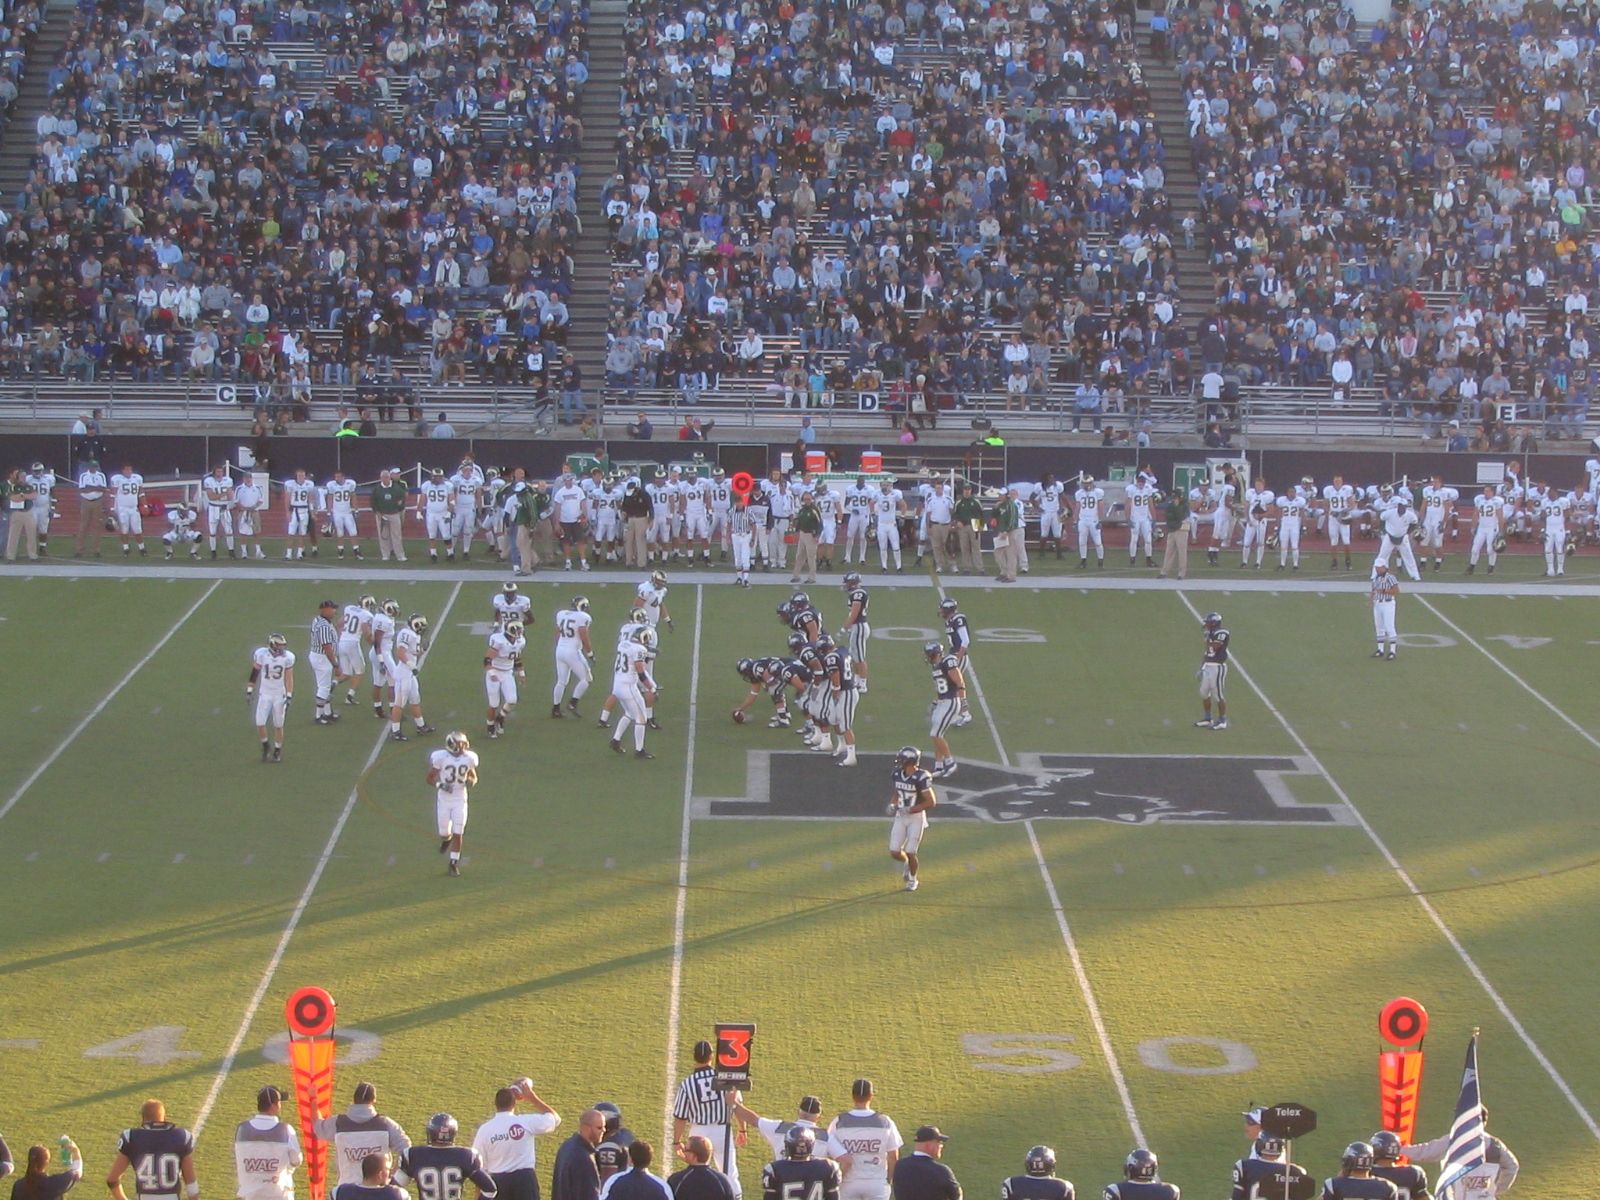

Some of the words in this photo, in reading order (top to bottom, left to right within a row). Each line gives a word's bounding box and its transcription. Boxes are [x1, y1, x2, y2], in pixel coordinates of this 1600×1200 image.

[219, 386, 234, 402] C
[861, 394, 877, 410] D
[1500, 406, 1513, 421] E
[122, 483, 138, 495] 58
[294, 490, 308, 502] 18
[428, 490, 445, 502] 95
[459, 484, 475, 495] 62
[881, 501, 890, 513] 3
[1281, 506, 1297, 517] 22
[559, 618, 576, 638] 45
[264, 664, 283, 680] 13
[444, 764, 468, 784] 39
[718, 1029, 752, 1068] 3
[1275, 1107, 1302, 1117] Telex
[843, 1138, 881, 1154] WAC
[136, 1153, 180, 1190] 40
[243, 1158, 279, 1173] WAC
[417, 1166, 464, 1200] 96
[1274, 1173, 1300, 1183] Teex
